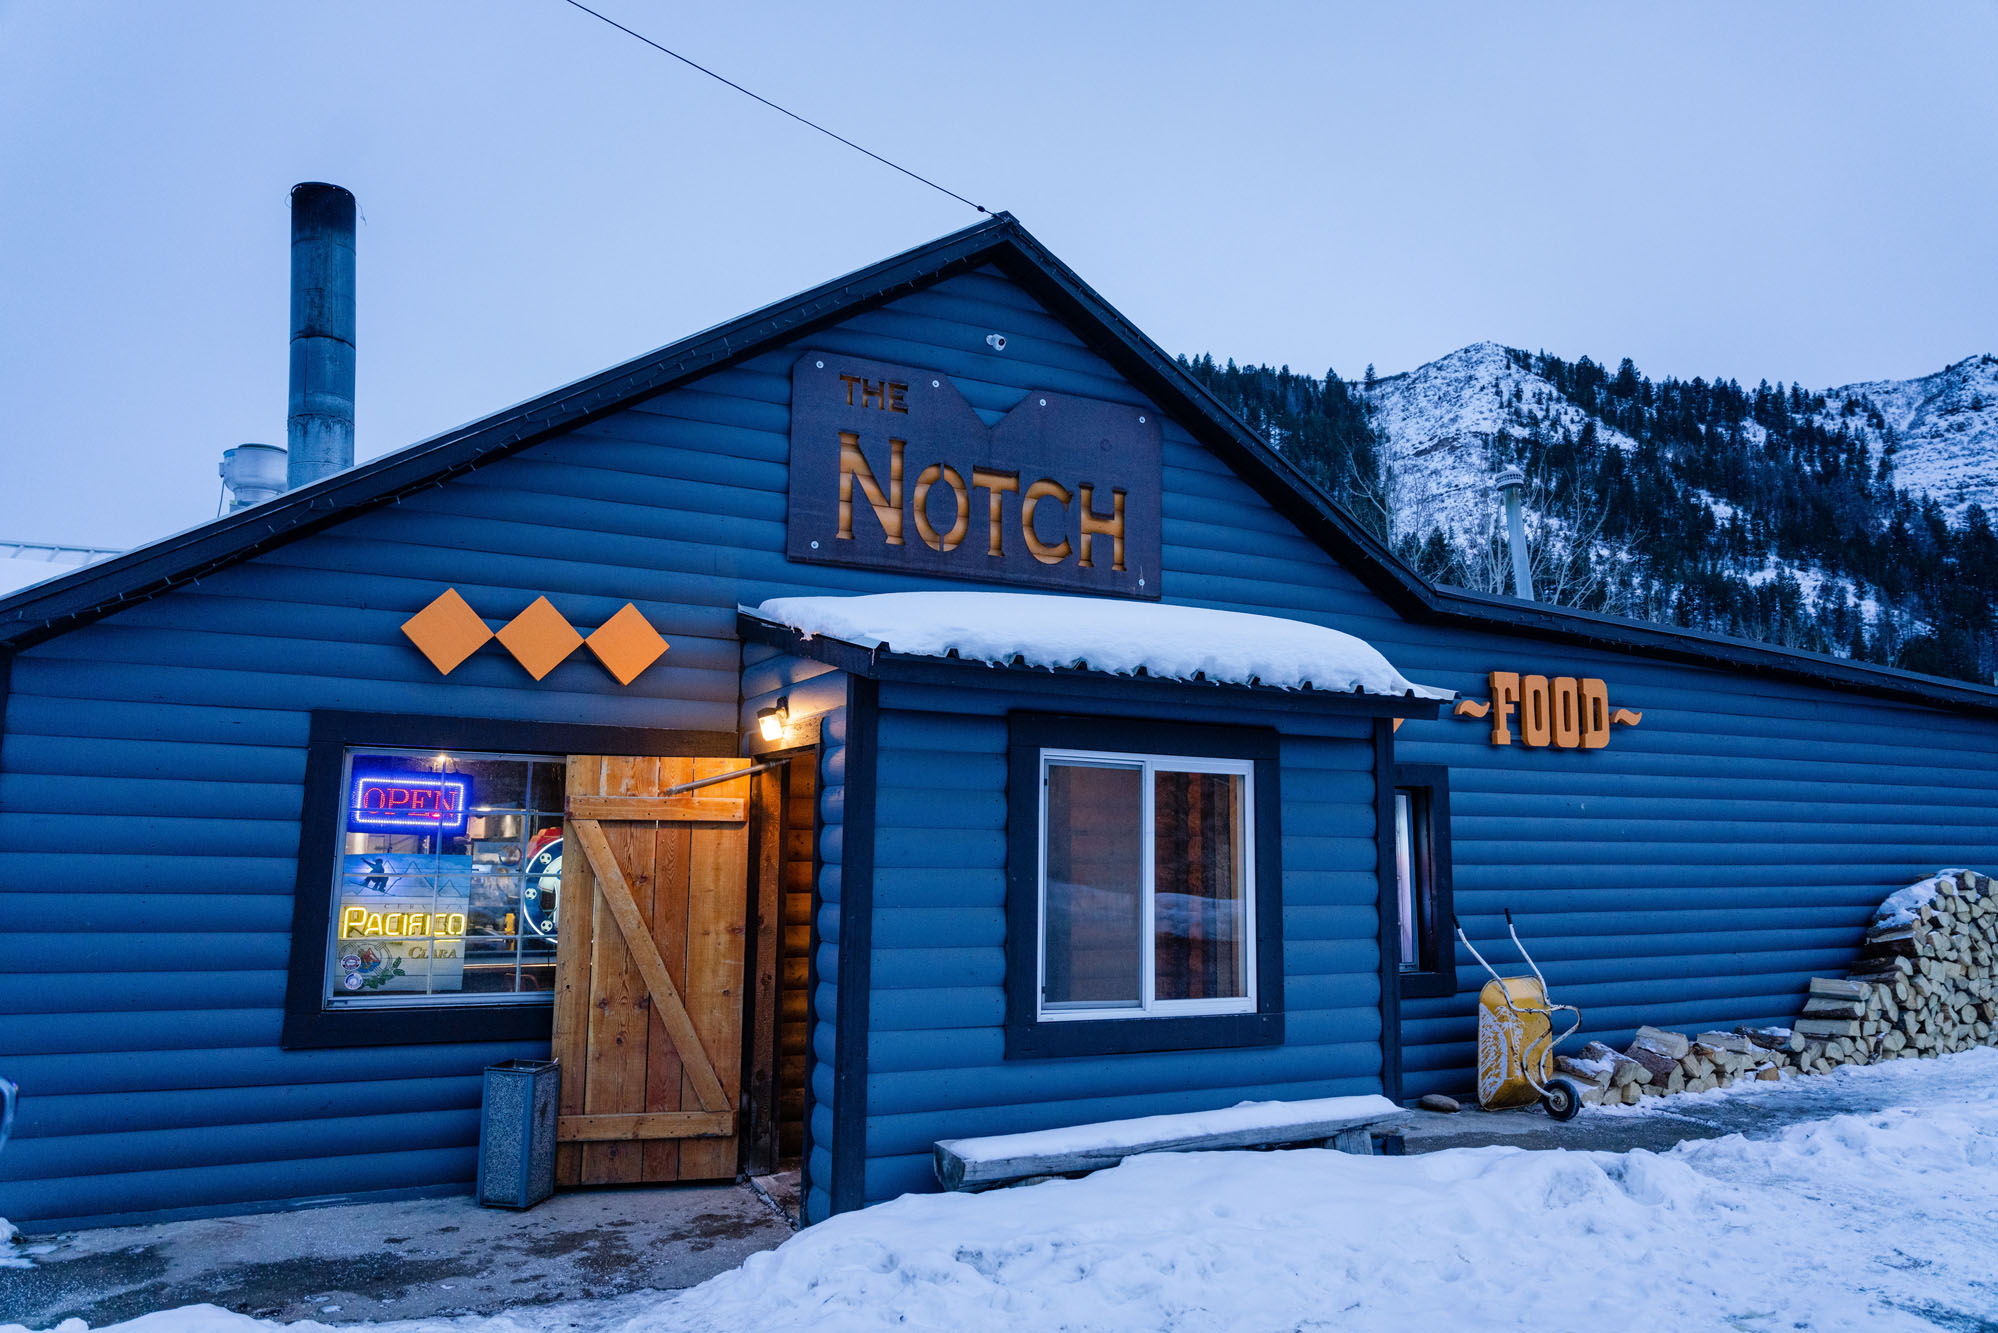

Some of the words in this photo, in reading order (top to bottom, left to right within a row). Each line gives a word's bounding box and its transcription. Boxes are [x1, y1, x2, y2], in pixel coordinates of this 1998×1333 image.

[839, 374, 908, 414] THE
[836, 431, 1127, 571] NOTCH
[363, 787, 458, 818] OPEN
[343, 907, 466, 938] PACIFICO
